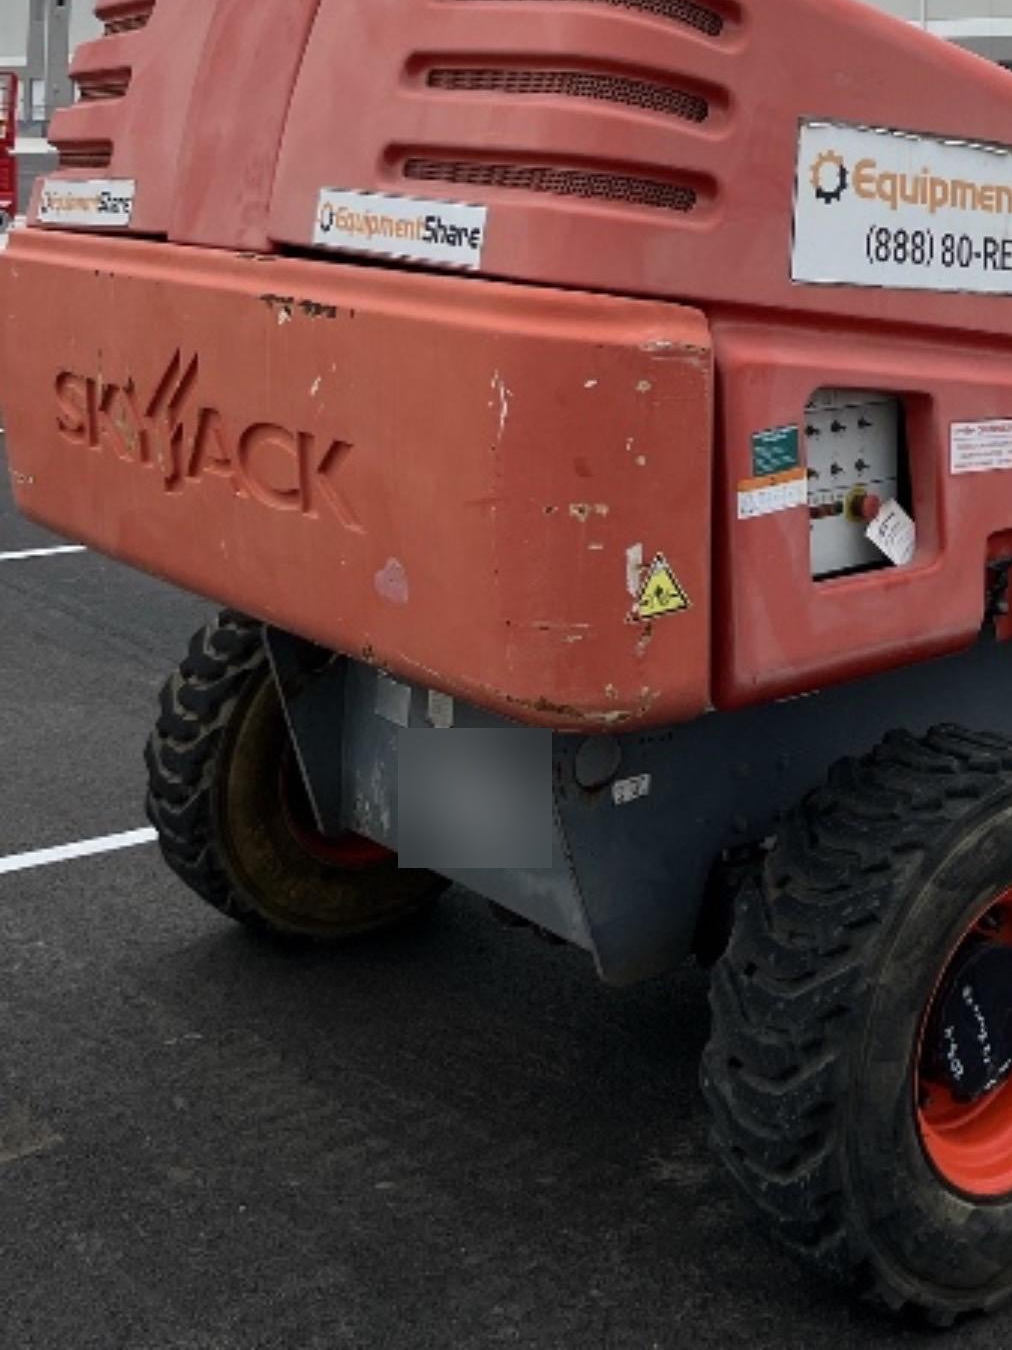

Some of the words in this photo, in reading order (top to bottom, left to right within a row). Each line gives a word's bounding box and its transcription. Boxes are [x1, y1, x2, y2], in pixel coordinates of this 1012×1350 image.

[334, 206, 480, 249] EquipmentShare
[866, 224, 934, 267] (888)
[55, 347, 366, 534] SKYJACK
